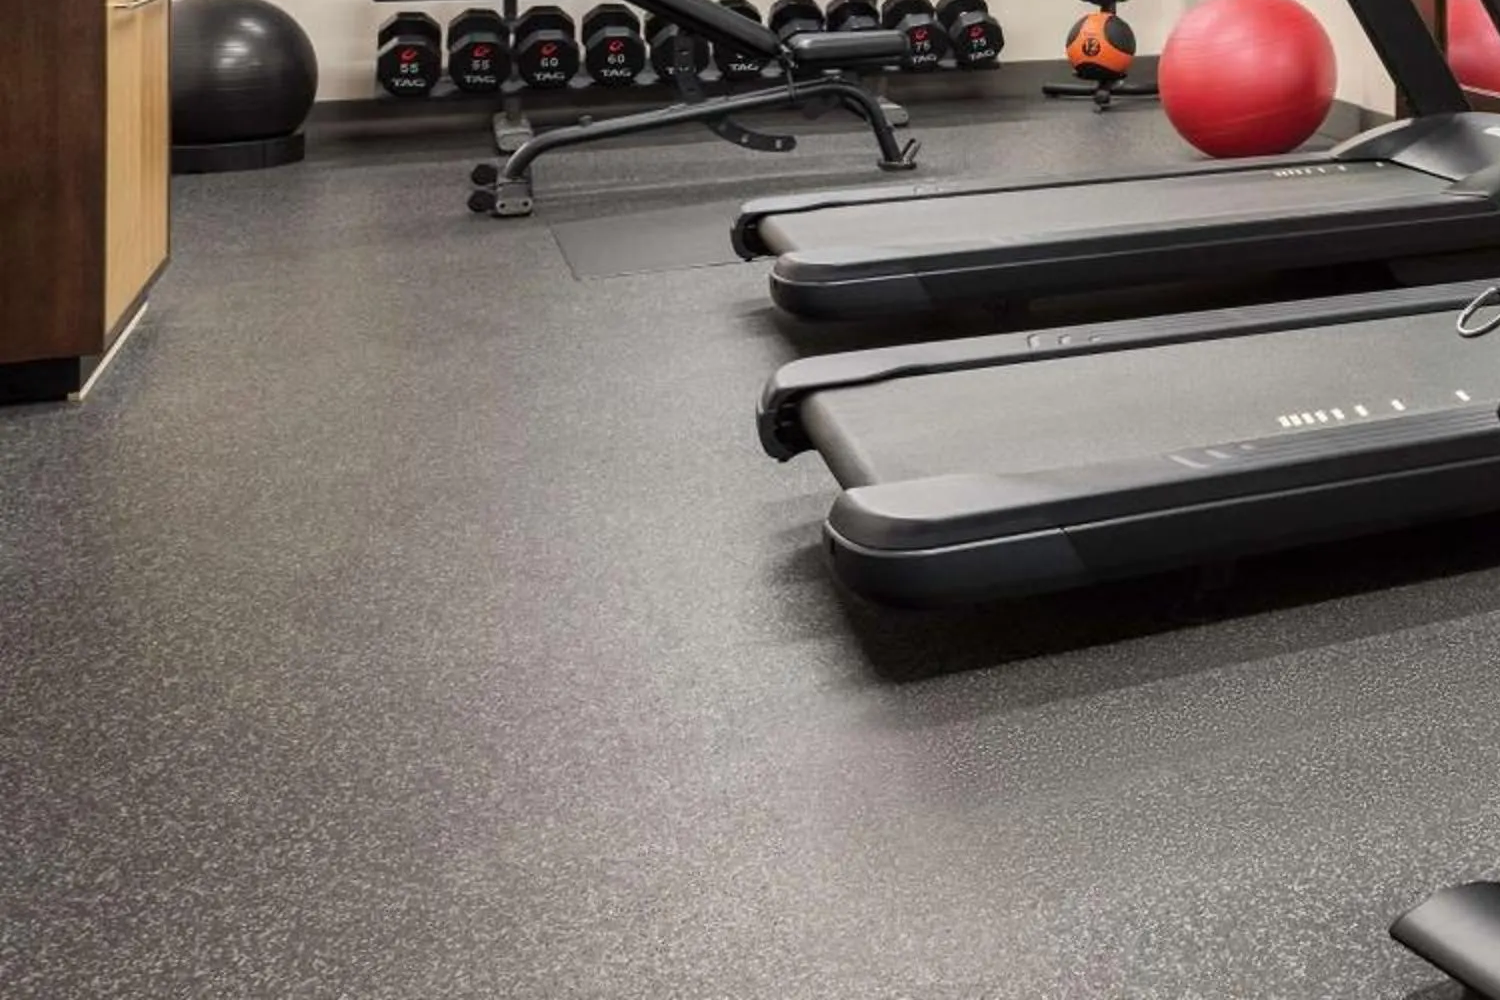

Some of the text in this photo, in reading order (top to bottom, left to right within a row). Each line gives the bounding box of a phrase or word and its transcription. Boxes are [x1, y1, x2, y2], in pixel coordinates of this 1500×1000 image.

[607, 54, 625, 64] 60
[911, 54, 937, 64] TAG
[969, 49, 995, 61] TAG
[729, 63, 760, 71] TAG
[534, 72, 565, 81] TAG
[601, 68, 632, 77] TAG
[392, 78, 426, 87] TAG
[464, 75, 496, 84] TAG
